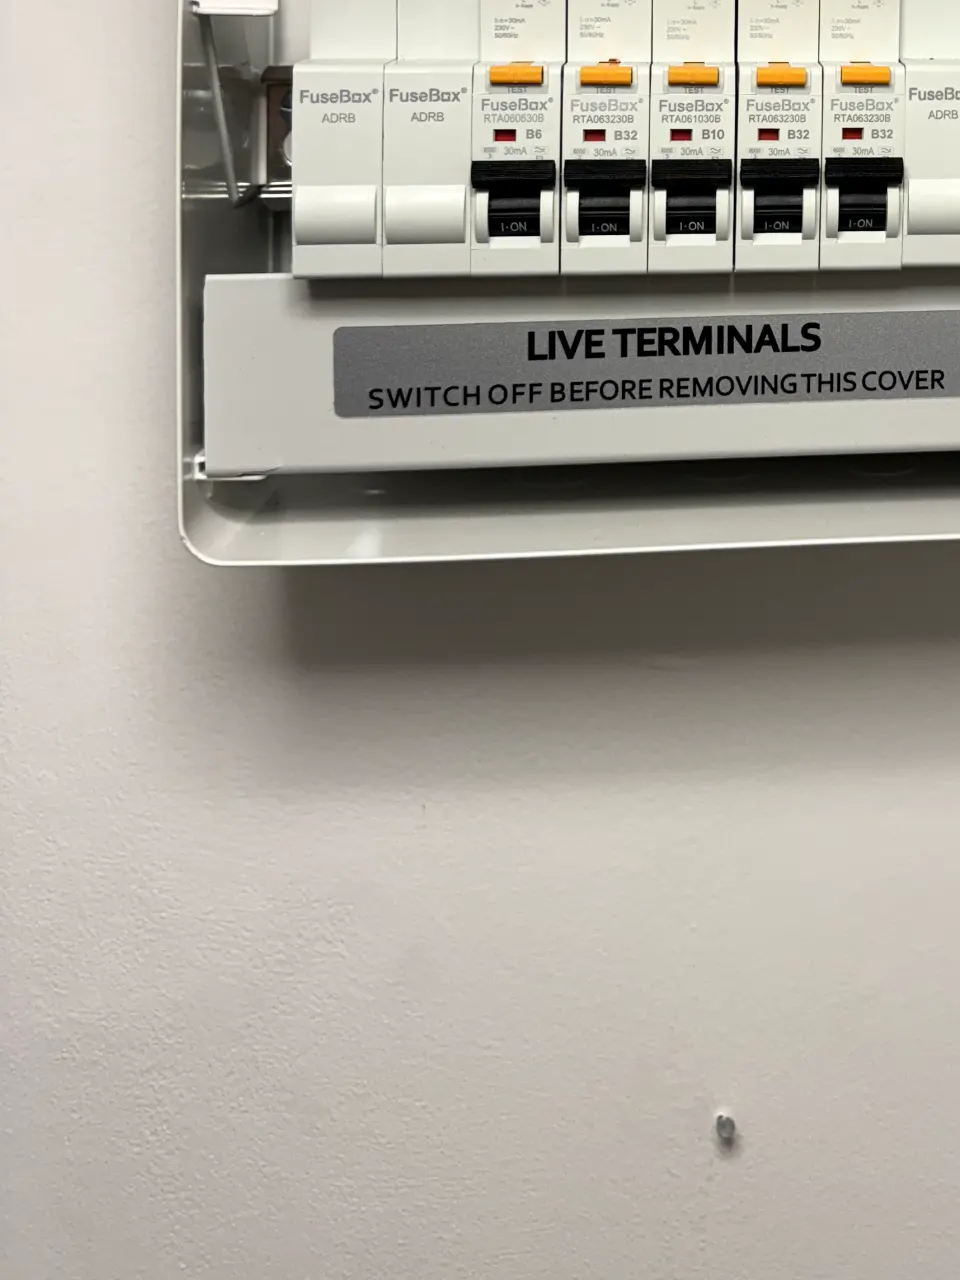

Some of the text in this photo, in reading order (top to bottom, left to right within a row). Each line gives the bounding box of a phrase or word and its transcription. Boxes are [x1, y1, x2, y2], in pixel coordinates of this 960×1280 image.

[321, 113, 356, 123] ADRB
[411, 112, 445, 122] ADRB
[928, 110, 958, 120] ADRB
[526, 129, 542, 139] B6
[614, 130, 638, 140] B32
[702, 129, 725, 139] B10
[787, 129, 810, 139] B32
[871, 129, 893, 139] B32
[504, 147, 527, 156] 30mA
[594, 148, 617, 157] 30mA
[680, 147, 703, 156] 30mA
[768, 147, 790, 156] 30mA
[852, 147, 874, 155] 30mA
[527, 322, 821, 361] LIVE TERMINALS
[369, 369, 945, 411] SWITCH OFF BEFORE REMOVING THIS COVER
